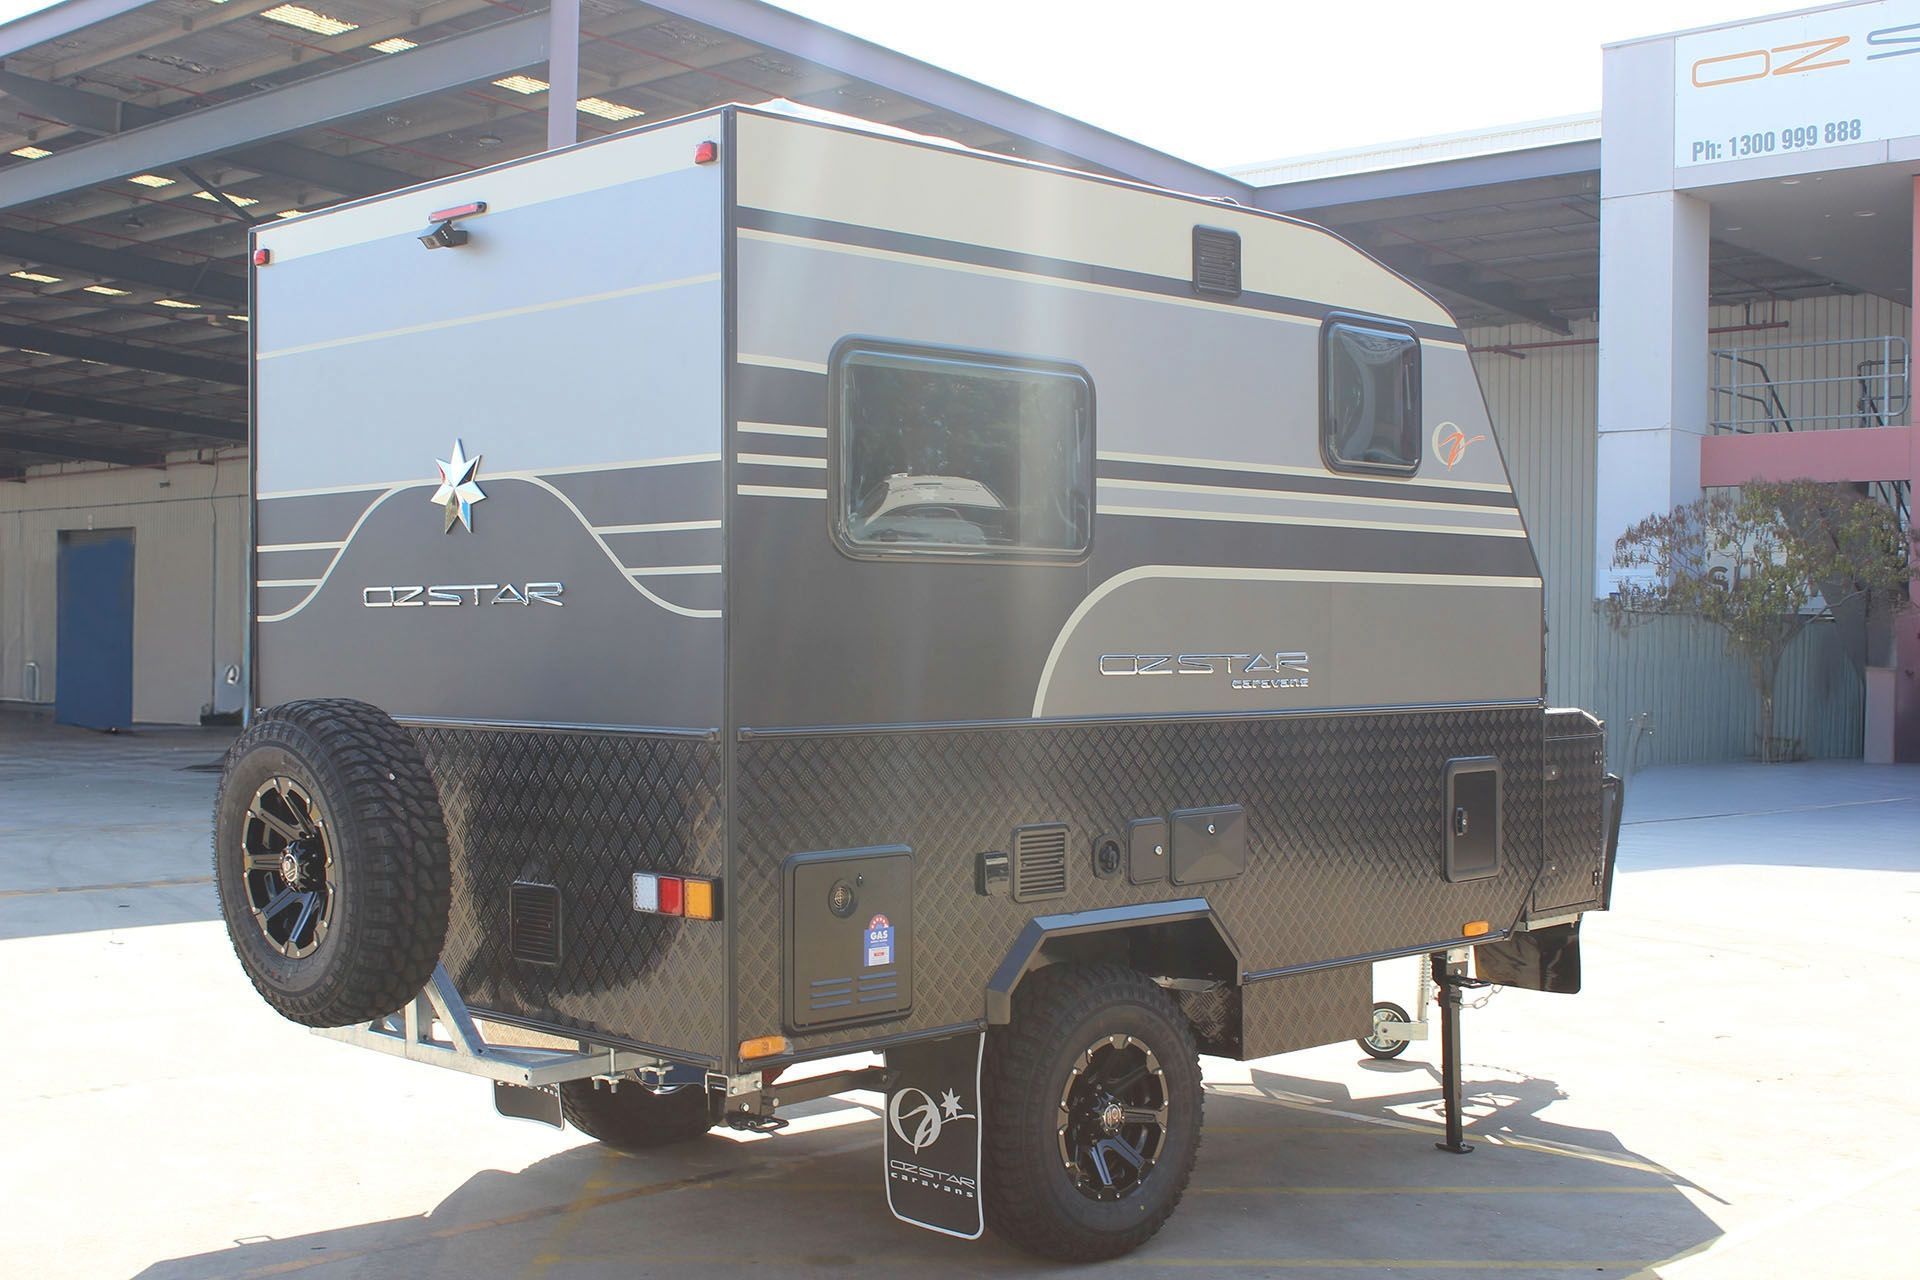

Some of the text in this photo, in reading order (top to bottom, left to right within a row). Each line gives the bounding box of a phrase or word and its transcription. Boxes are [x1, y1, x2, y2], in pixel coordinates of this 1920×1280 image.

[1692, 119, 1862, 162] Ph: 1300 999 888
[363, 582, 564, 607] OZSTAR
[1099, 651, 1310, 676] OZSTAR
[870, 930, 888, 940] GAS
[890, 1160, 976, 1190] OZSTAR
[890, 1172, 974, 1198] caravans
